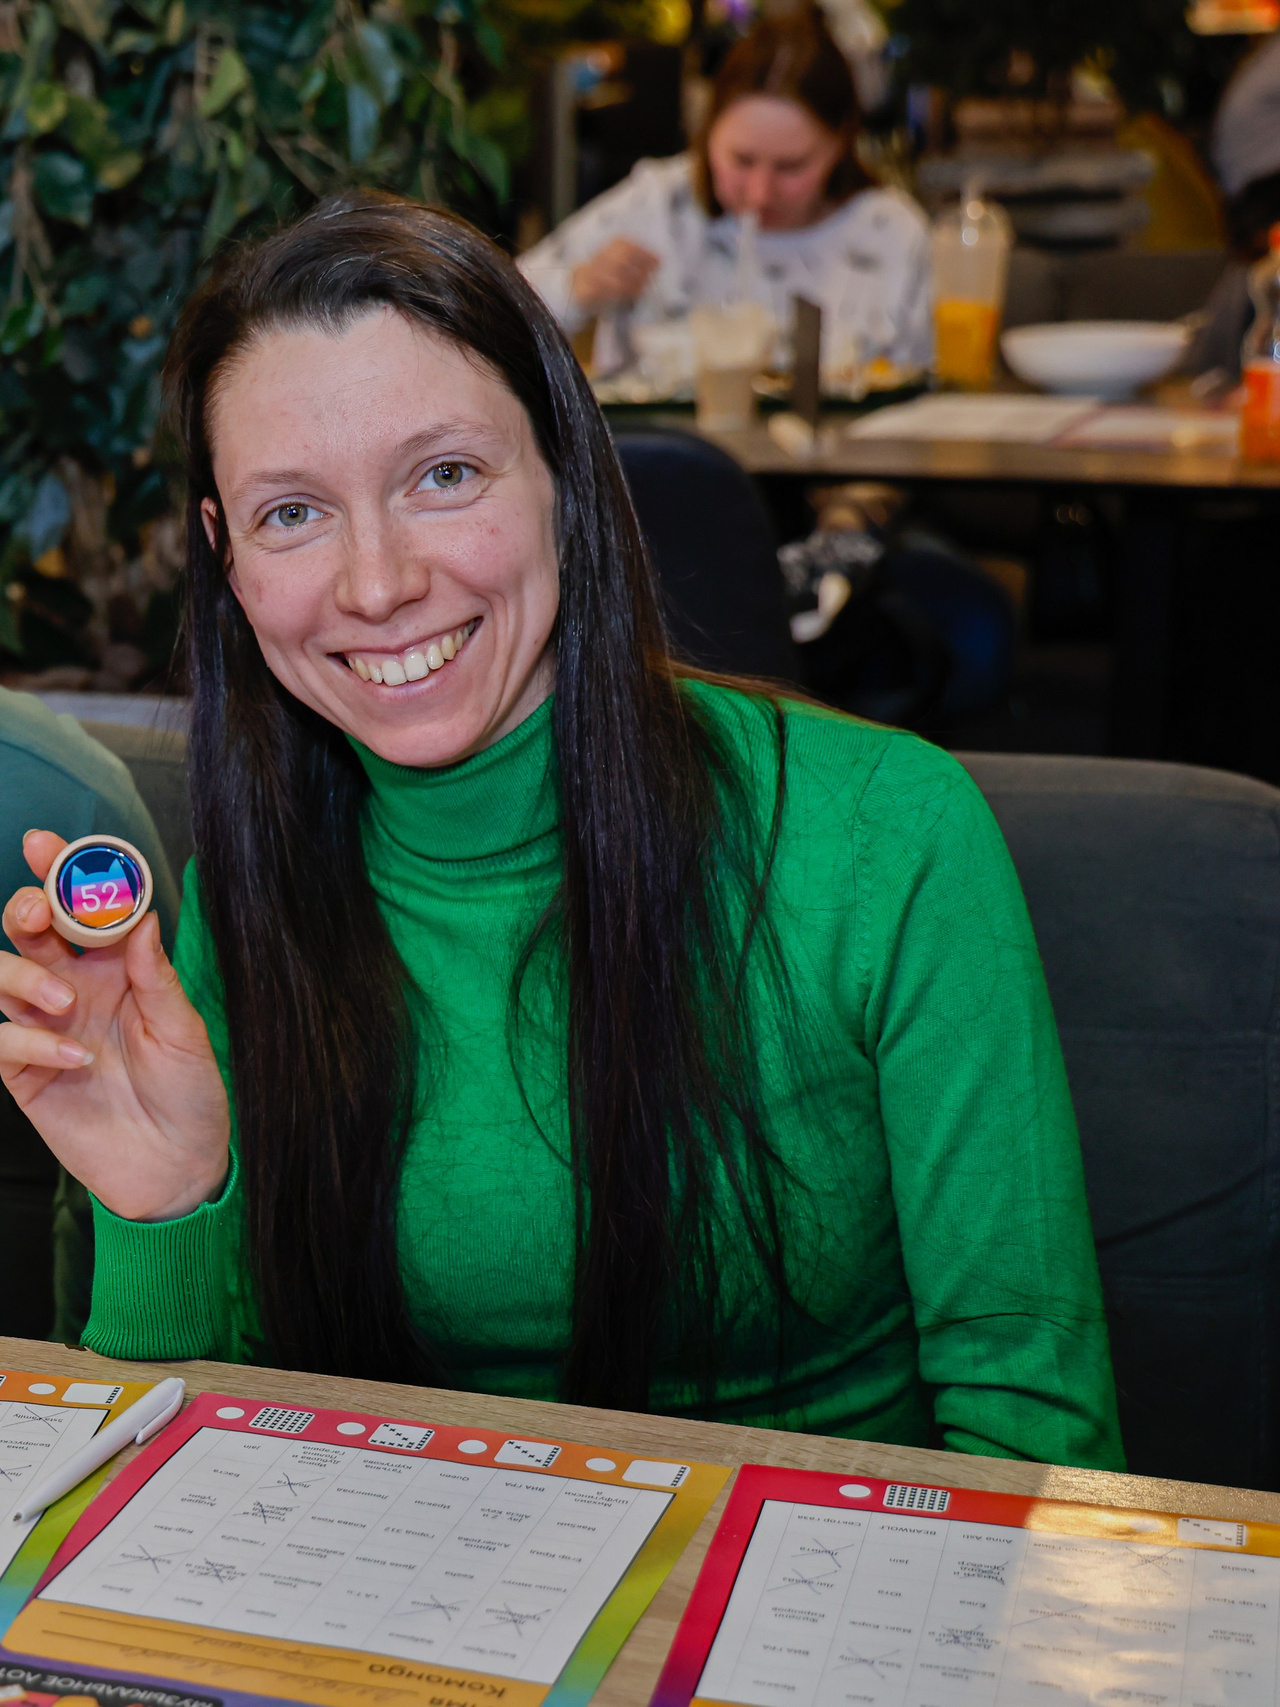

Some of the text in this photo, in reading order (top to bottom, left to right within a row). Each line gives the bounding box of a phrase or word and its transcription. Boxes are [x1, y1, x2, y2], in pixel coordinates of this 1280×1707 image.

[80, 881, 122, 912] 52
[299, 1444, 347, 1455] Гагарина
[300, 1450, 339, 1459] Полина
[294, 1458, 329, 1468] Ирина
[297, 1454, 342, 1465] Дубцова
[360, 1458, 413, 1470] Куртукова
[209, 1468, 242, 1478] Баста
[362, 1463, 404, 1473] Татьяна
[436, 1471, 472, 1481] Queen
[333, 1486, 390, 1500] Ленинград
[522, 1484, 547, 1492] ВИА
[177, 1496, 218, 1507] Андрей
[186, 1492, 218, 1501] Губин
[561, 1490, 630, 1505] Шуфутински
[571, 1497, 613, 1507] Михаил
[412, 1498, 453, 1509] Иракли
[478, 1506, 532, 1519] Alicia Keys
[308, 1515, 368, 1528] Клава Кока
[795, 1514, 862, 1527] Сектор газа
[382, 1525, 436, 1539] Город 312
[877, 1524, 936, 1535] BEARWOLF
[454, 1535, 512, 1549] Аллегрова
[960, 1532, 1013, 1545] Anna Asti
[283, 1542, 347, 1556] Кайратовна
[461, 1541, 497, 1552] Ирина
[293, 1549, 328, 1559] Ирина
[527, 1549, 584, 1562] Егор Крид
[352, 1555, 418, 1570] Дима Билан
[875, 1588, 902, 1597] Юта
[369, 1664, 507, 1698] Команда
